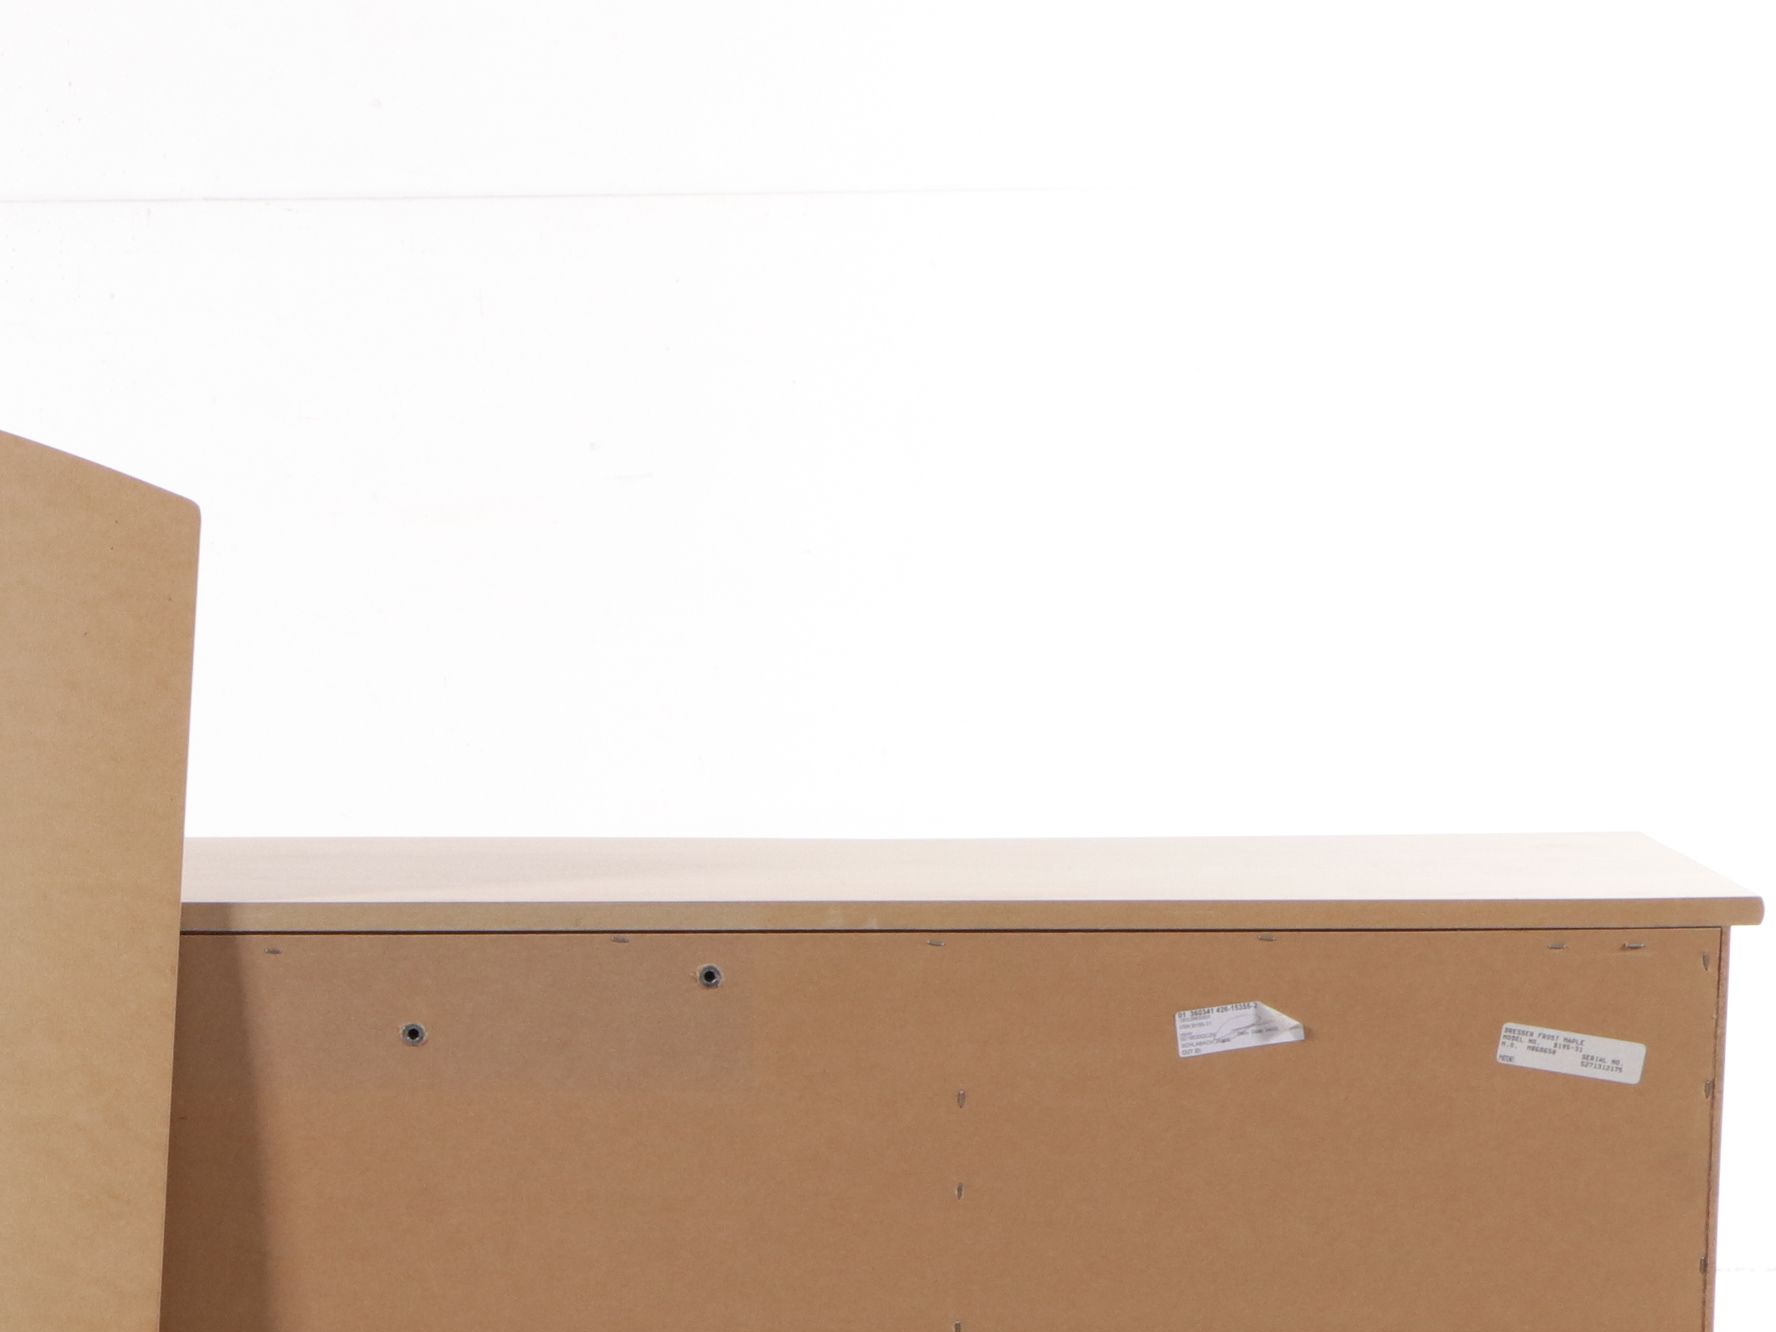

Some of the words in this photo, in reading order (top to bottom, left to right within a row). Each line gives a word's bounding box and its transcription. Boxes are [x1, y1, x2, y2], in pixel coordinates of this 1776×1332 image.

[1502, 1034, 1523, 1043] MODEL
[1538, 1032, 1559, 1041] FROST
[1563, 1037, 1585, 1046] MAPLE
[1581, 1054, 1606, 1063] SERIAL
